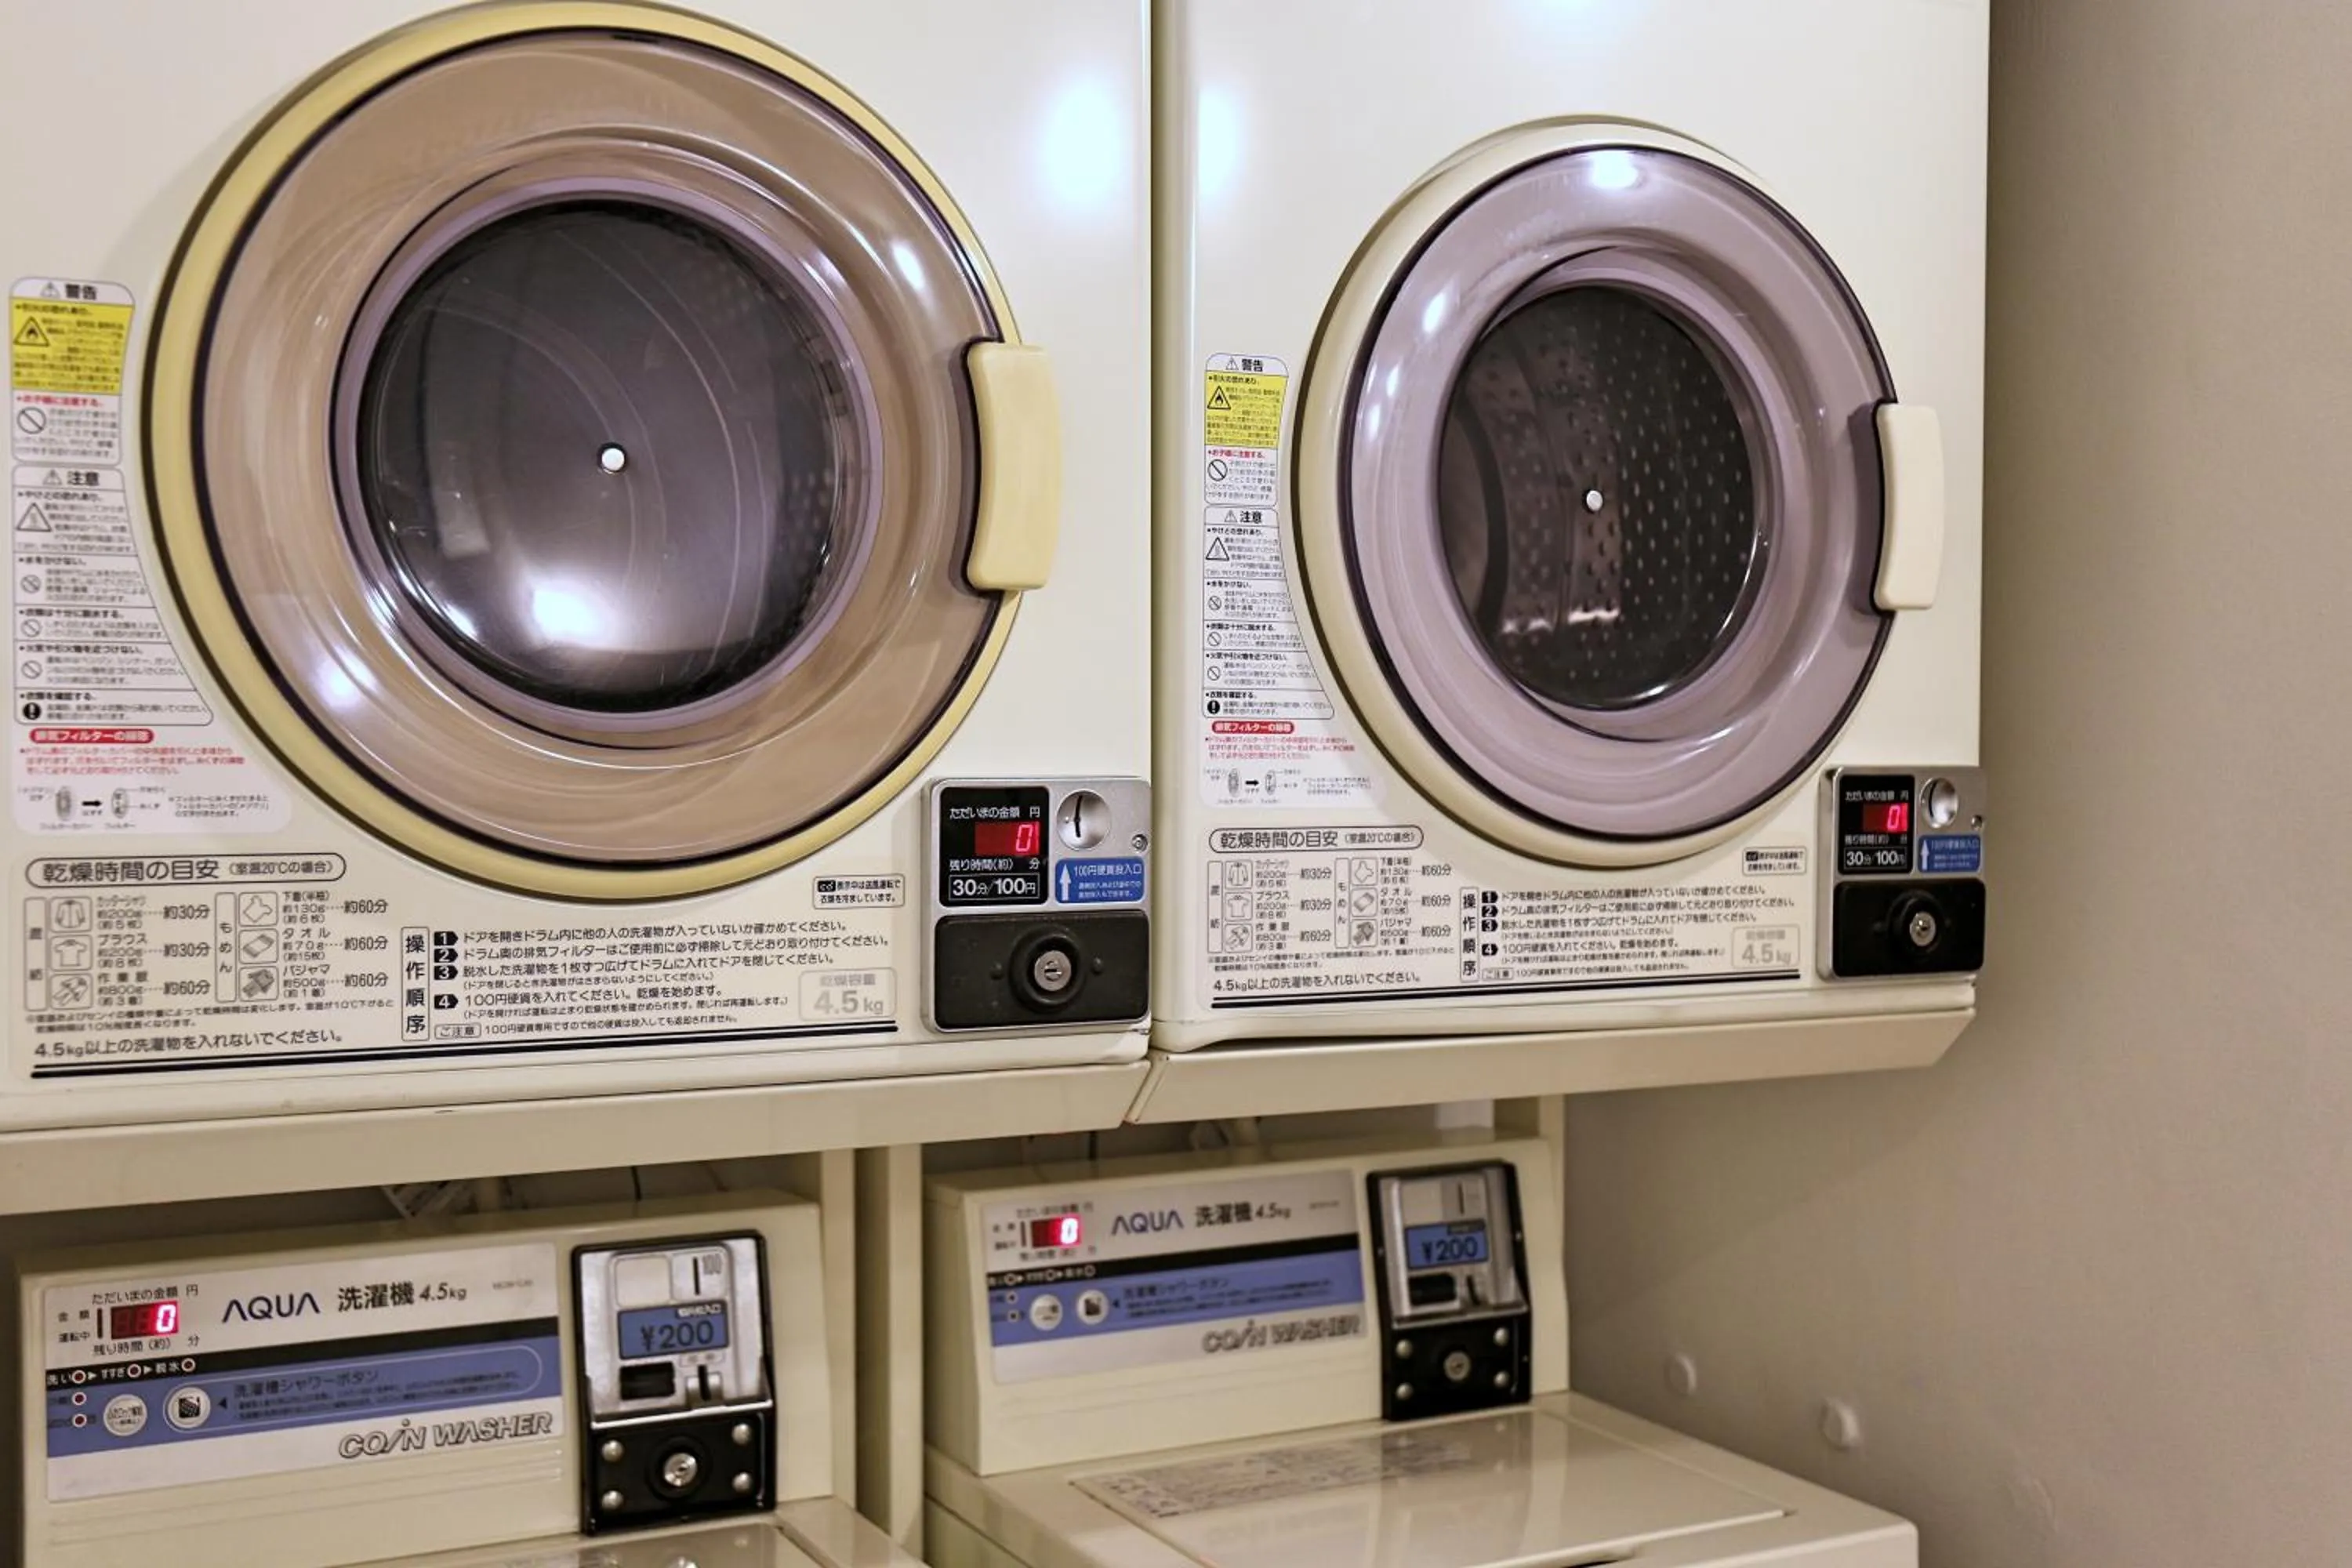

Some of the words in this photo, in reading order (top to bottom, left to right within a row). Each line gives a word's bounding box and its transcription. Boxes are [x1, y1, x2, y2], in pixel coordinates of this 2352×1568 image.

[67, 470, 100, 486] 注意
[1240, 511, 1263, 524] 注意
[949, 806, 1020, 819] ただいまの金額
[1029, 806, 1041, 818] 円
[1886, 804, 1900, 830] 0
[1015, 823, 1033, 852] 0
[1220, 830, 1338, 848] 乾燥時間の目安
[42, 859, 220, 883] 乾燥時間の目安
[1029, 858, 1041, 870] 分
[163, 904, 211, 920] 約30分
[343, 899, 389, 914] 約60分
[97, 933, 148, 946] ブラウス
[282, 927, 331, 939] タオル
[163, 942, 211, 957] 約30分
[220, 923, 233, 974] もめん
[344, 935, 389, 950] 約60分
[283, 964, 331, 976] パジャマ
[163, 979, 211, 995] 約60分
[344, 971, 389, 988] 約60分
[405, 935, 426, 1034] 操作順序
[439, 1025, 475, 1038] ご注意
[34, 1029, 342, 1058] 4.5kg以上の洗濯物を入れないでください。
[1111, 1210, 1185, 1236] AQUA
[1195, 1201, 1252, 1228] 洗濯機
[1421, 1236, 1479, 1263] ¥200
[92, 1286, 179, 1305] ただいまの金額
[186, 1284, 198, 1296] 円
[337, 1281, 416, 1312] 洗濯機
[222, 1291, 321, 1323] AQUA
[156, 1302, 177, 1334] 0
[58, 1331, 91, 1343] 運転中
[187, 1335, 200, 1348] 分
[641, 1319, 714, 1352] ¥200
[1201, 1319, 1268, 1353] COIN
[338, 1417, 427, 1459] COIN
[432, 1410, 554, 1447] WASHER
